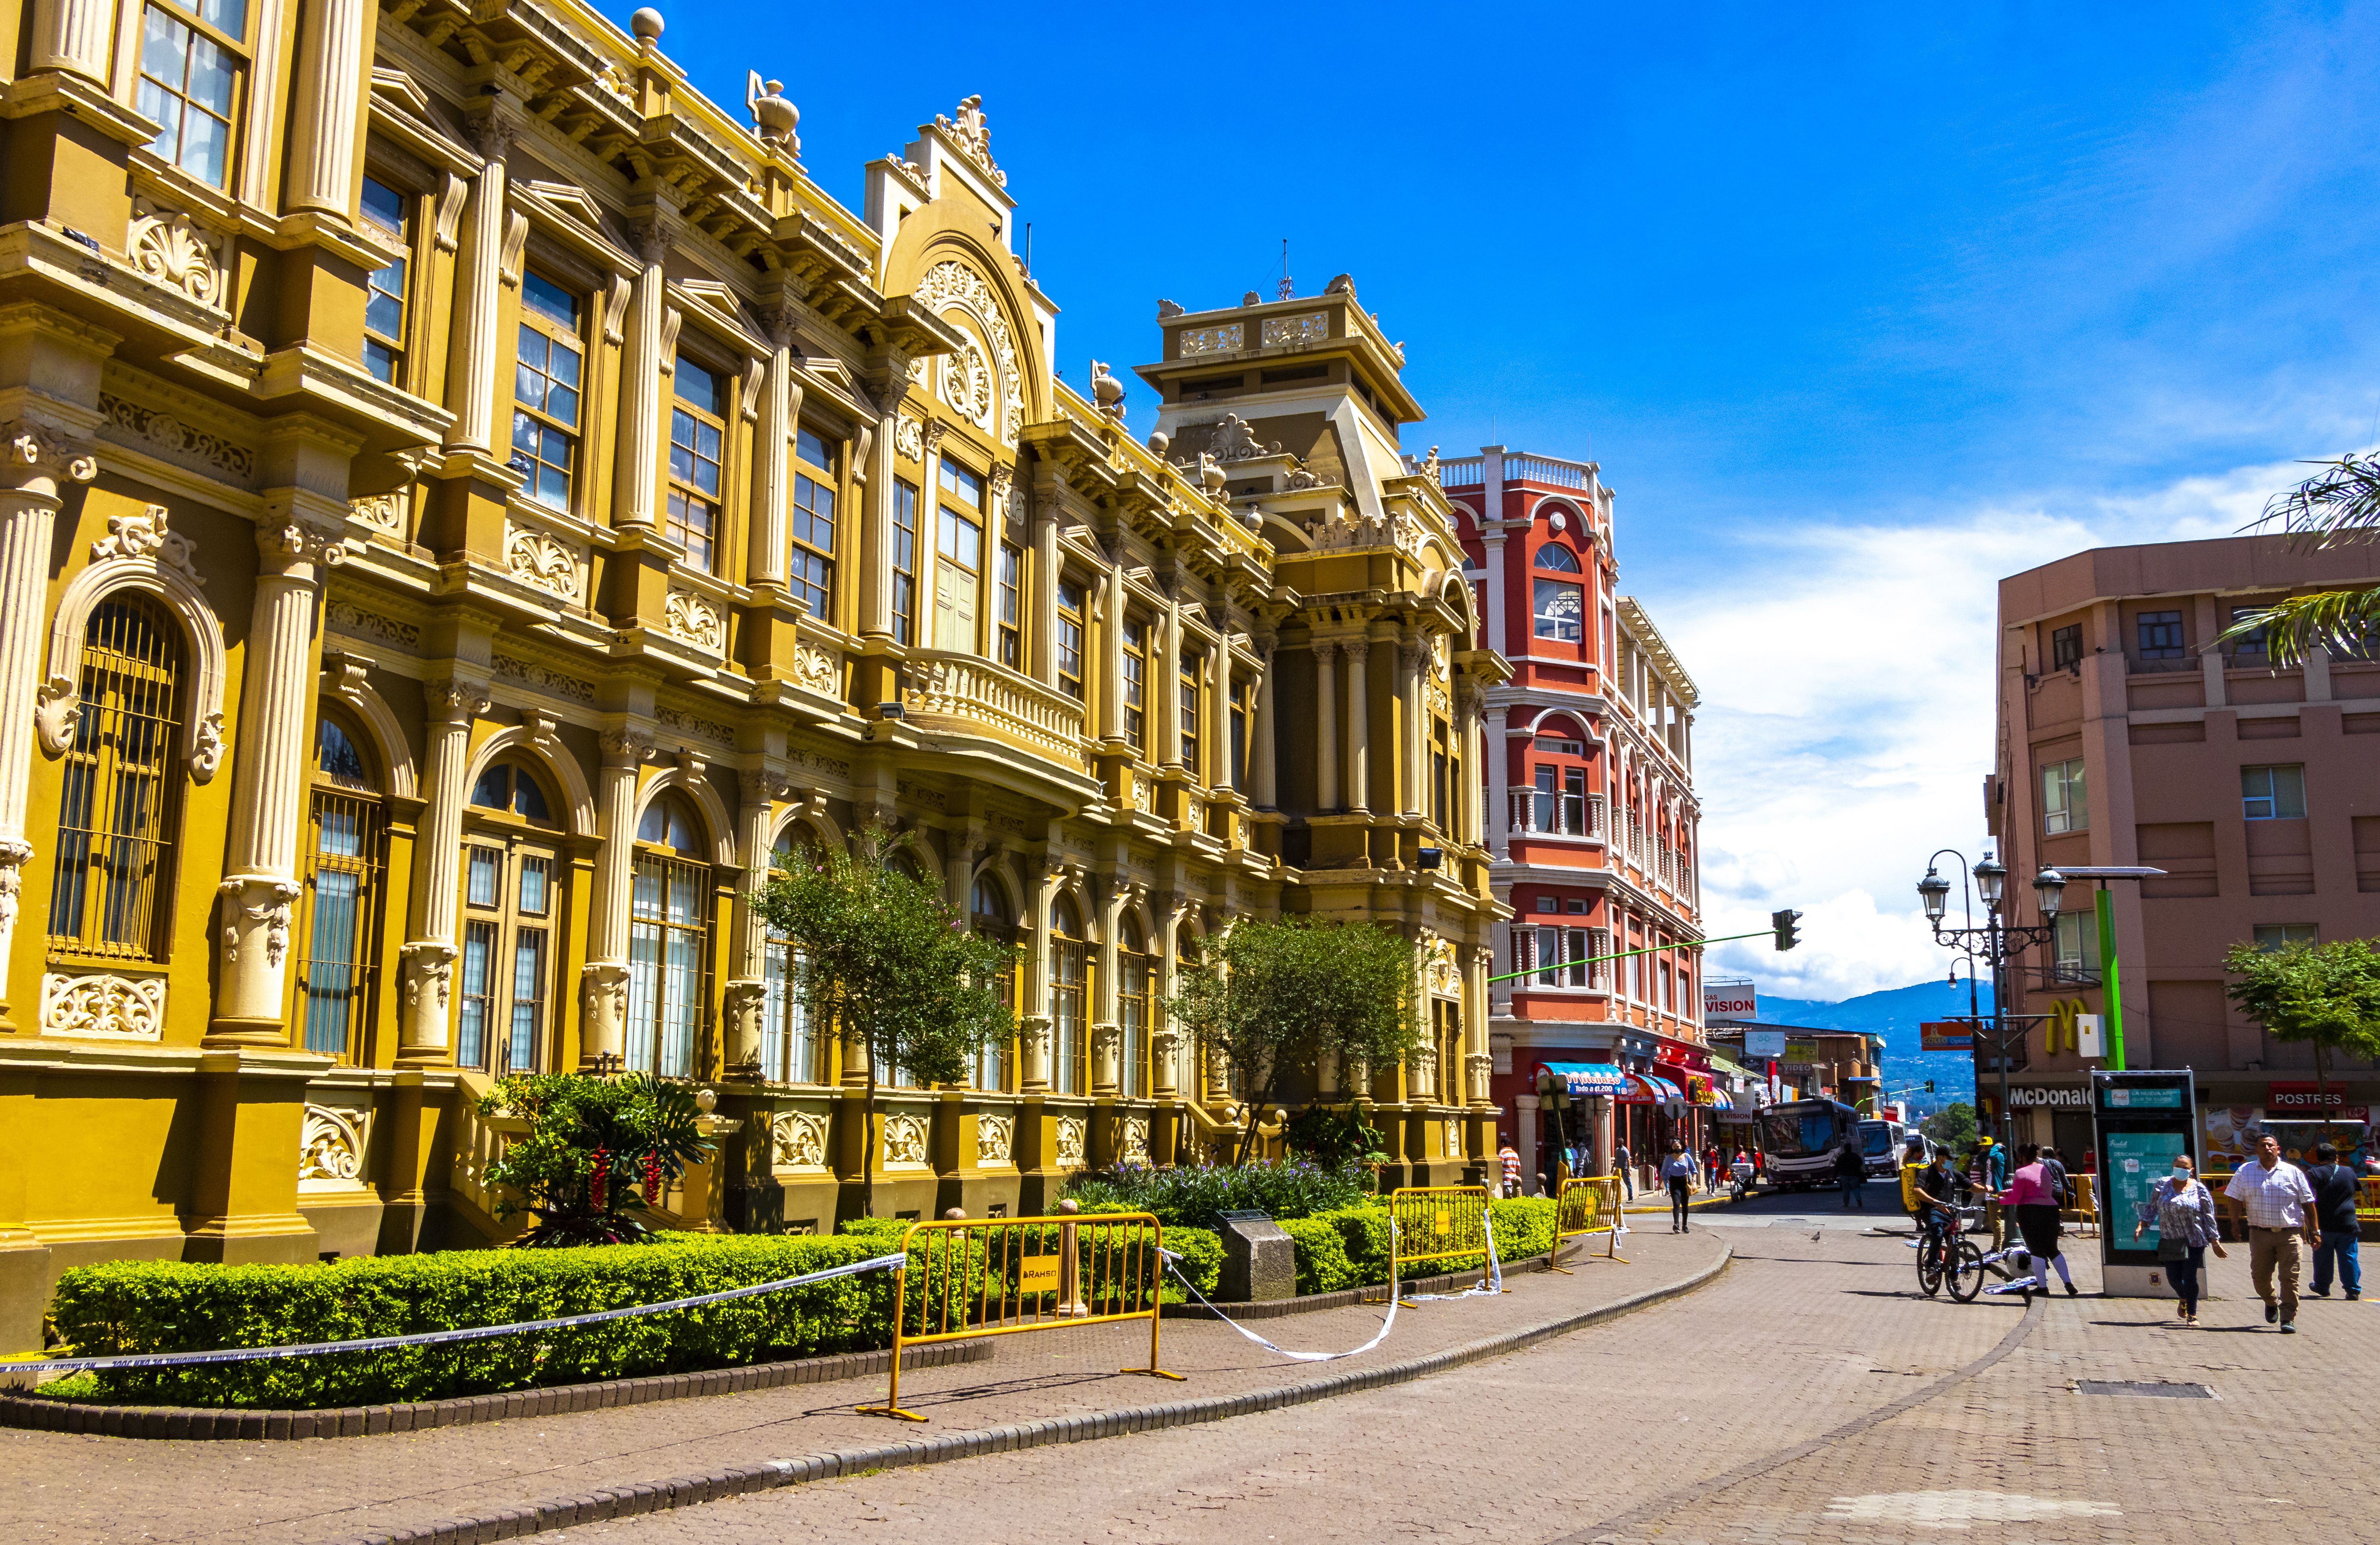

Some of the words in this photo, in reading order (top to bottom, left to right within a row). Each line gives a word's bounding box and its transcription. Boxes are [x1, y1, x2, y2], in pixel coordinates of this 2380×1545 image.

[1705, 1000, 1754, 1012] VISION
[2276, 1094, 2341, 1104] POSTRES
[1029, 1270, 1056, 1278] RAHSO
